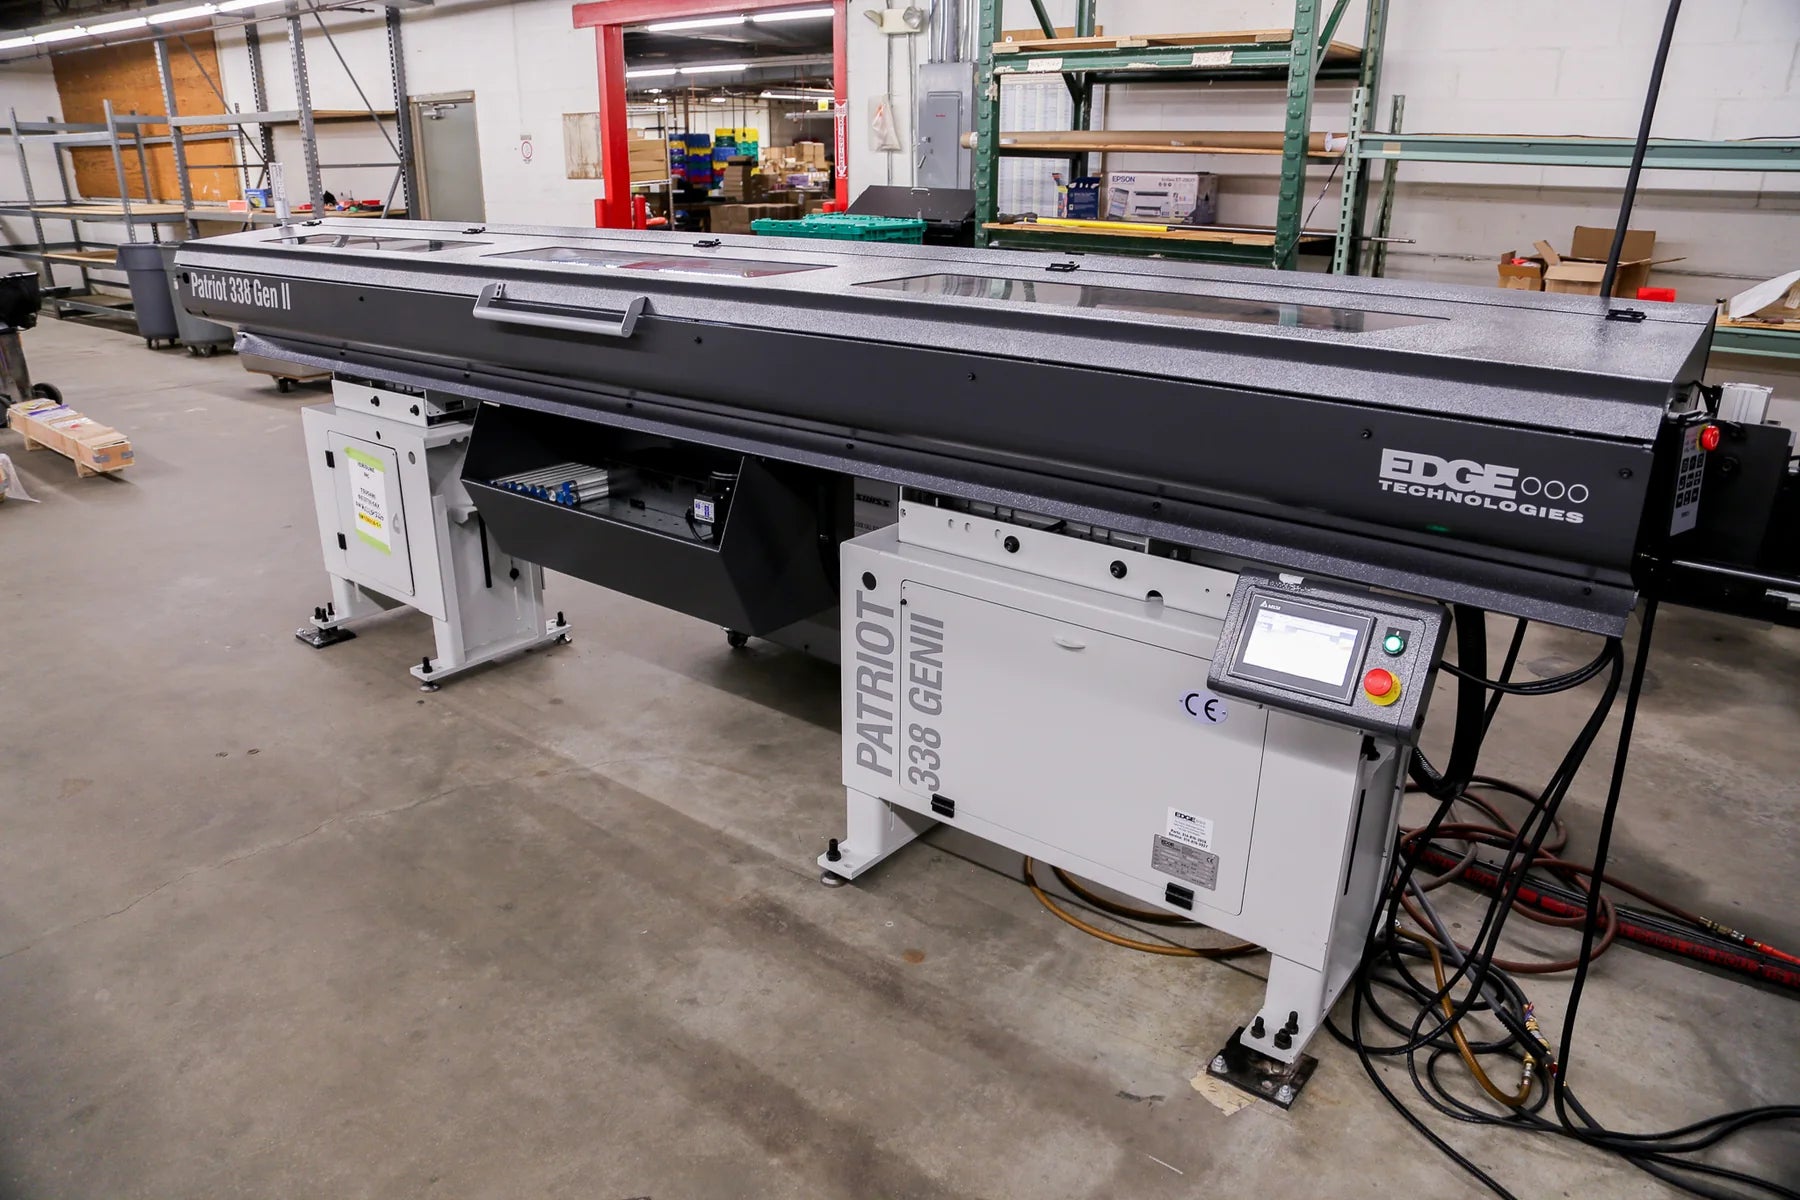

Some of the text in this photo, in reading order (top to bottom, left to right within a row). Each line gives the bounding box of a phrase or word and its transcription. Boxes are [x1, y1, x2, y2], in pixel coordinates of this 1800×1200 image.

[1112, 175, 1136, 183] EPSON
[190, 271, 291, 310] Patriot 338 Gen II
[1379, 448, 1520, 499] EDGE
[1378, 480, 1585, 524] TECHNOLOGIES
[855, 590, 895, 778] PATRIOT
[908, 612, 944, 792] 338 GENII
[1185, 693, 1219, 722] CE
[1174, 811, 1196, 823] EDGE
